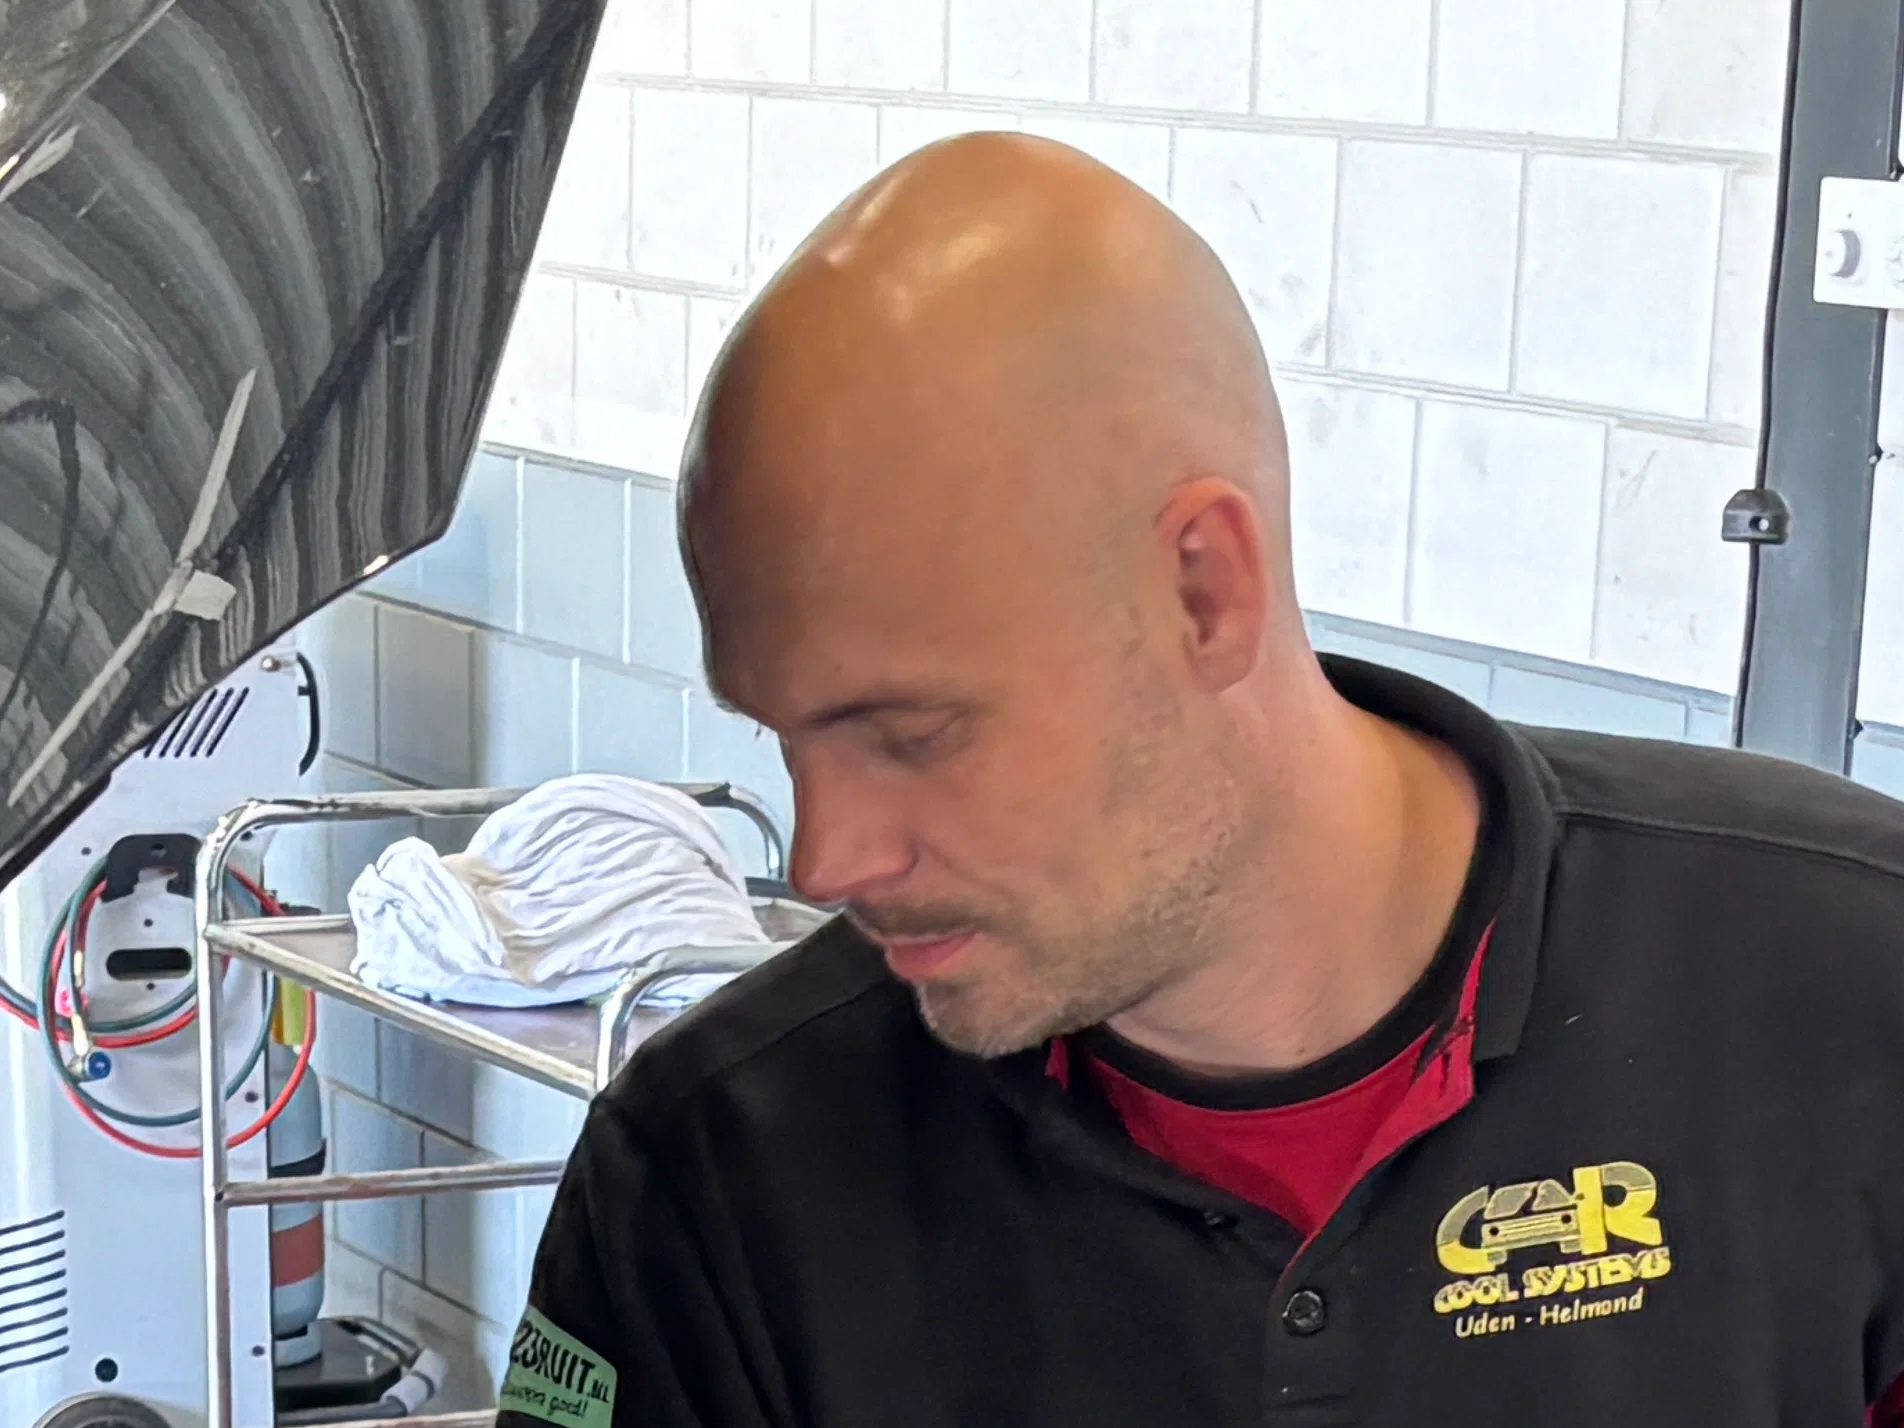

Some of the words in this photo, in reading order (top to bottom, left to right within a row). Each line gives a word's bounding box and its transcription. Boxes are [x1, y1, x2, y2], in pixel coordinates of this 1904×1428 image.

[1433, 1273, 1520, 1314] COOL
[1522, 1246, 1672, 1299] SYSTEMS
[1454, 1312, 1516, 1338] Uden
